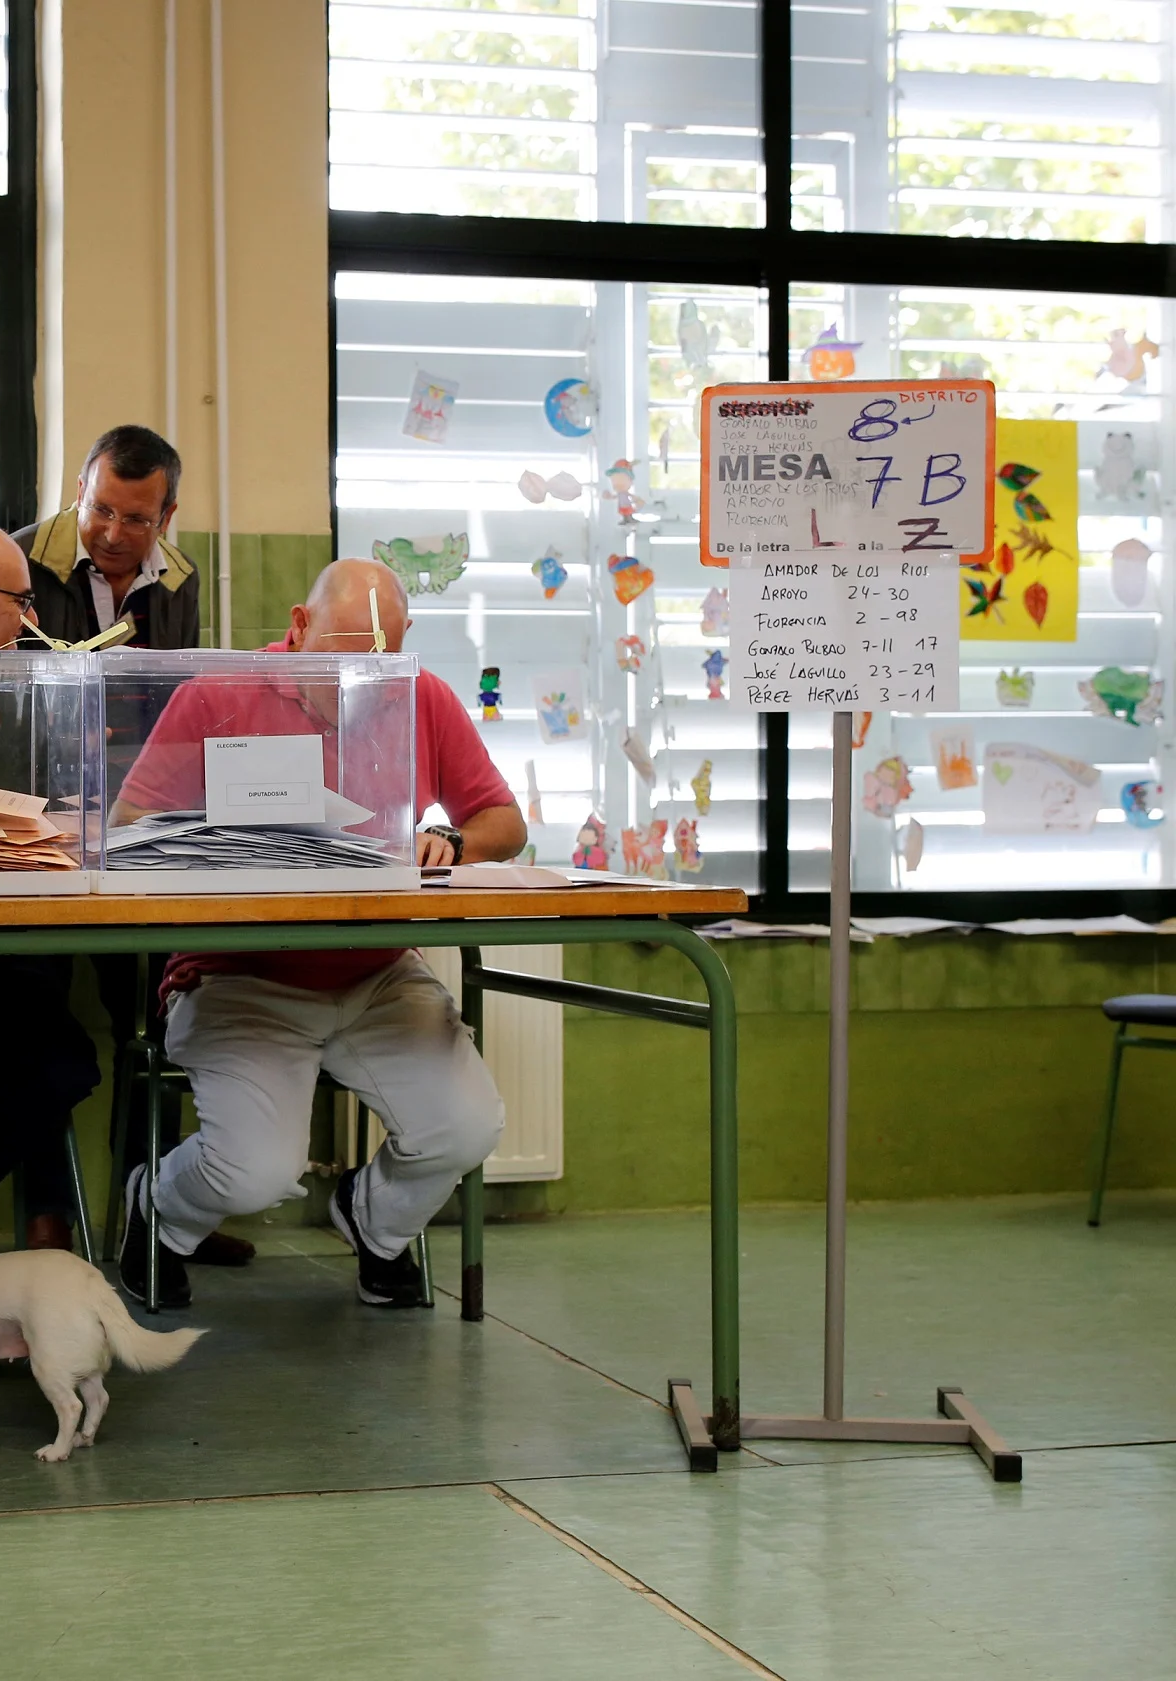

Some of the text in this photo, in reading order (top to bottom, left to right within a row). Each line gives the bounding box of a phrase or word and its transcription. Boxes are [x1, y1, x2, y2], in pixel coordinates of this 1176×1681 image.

[899, 391, 978, 404] DISTRITO
[776, 418, 818, 430] BILBAO
[848, 399, 899, 442] 8
[718, 453, 966, 509] MESA 7 B
[723, 482, 772, 495] AMADOR
[796, 482, 818, 495] LOS
[726, 495, 785, 508] ARROYO
[726, 511, 788, 527] FLORENCIA
[716, 508, 953, 554] De la letra L a la Z
[764, 563, 818, 577] AMADOR
[857, 564, 879, 578] LOS
[901, 562, 929, 577] RIOS
[761, 585, 808, 600] ARROYO
[754, 612, 827, 631] FLORENCIA
[801, 639, 846, 655] BILBAO
[915, 636, 938, 650] 17
[789, 662, 846, 680] LAGUILLO
[747, 683, 792, 704] PÉREZ
[808, 683, 859, 704] HERVÁS
[248, 790, 288, 798] DIPUTADOS/AS
